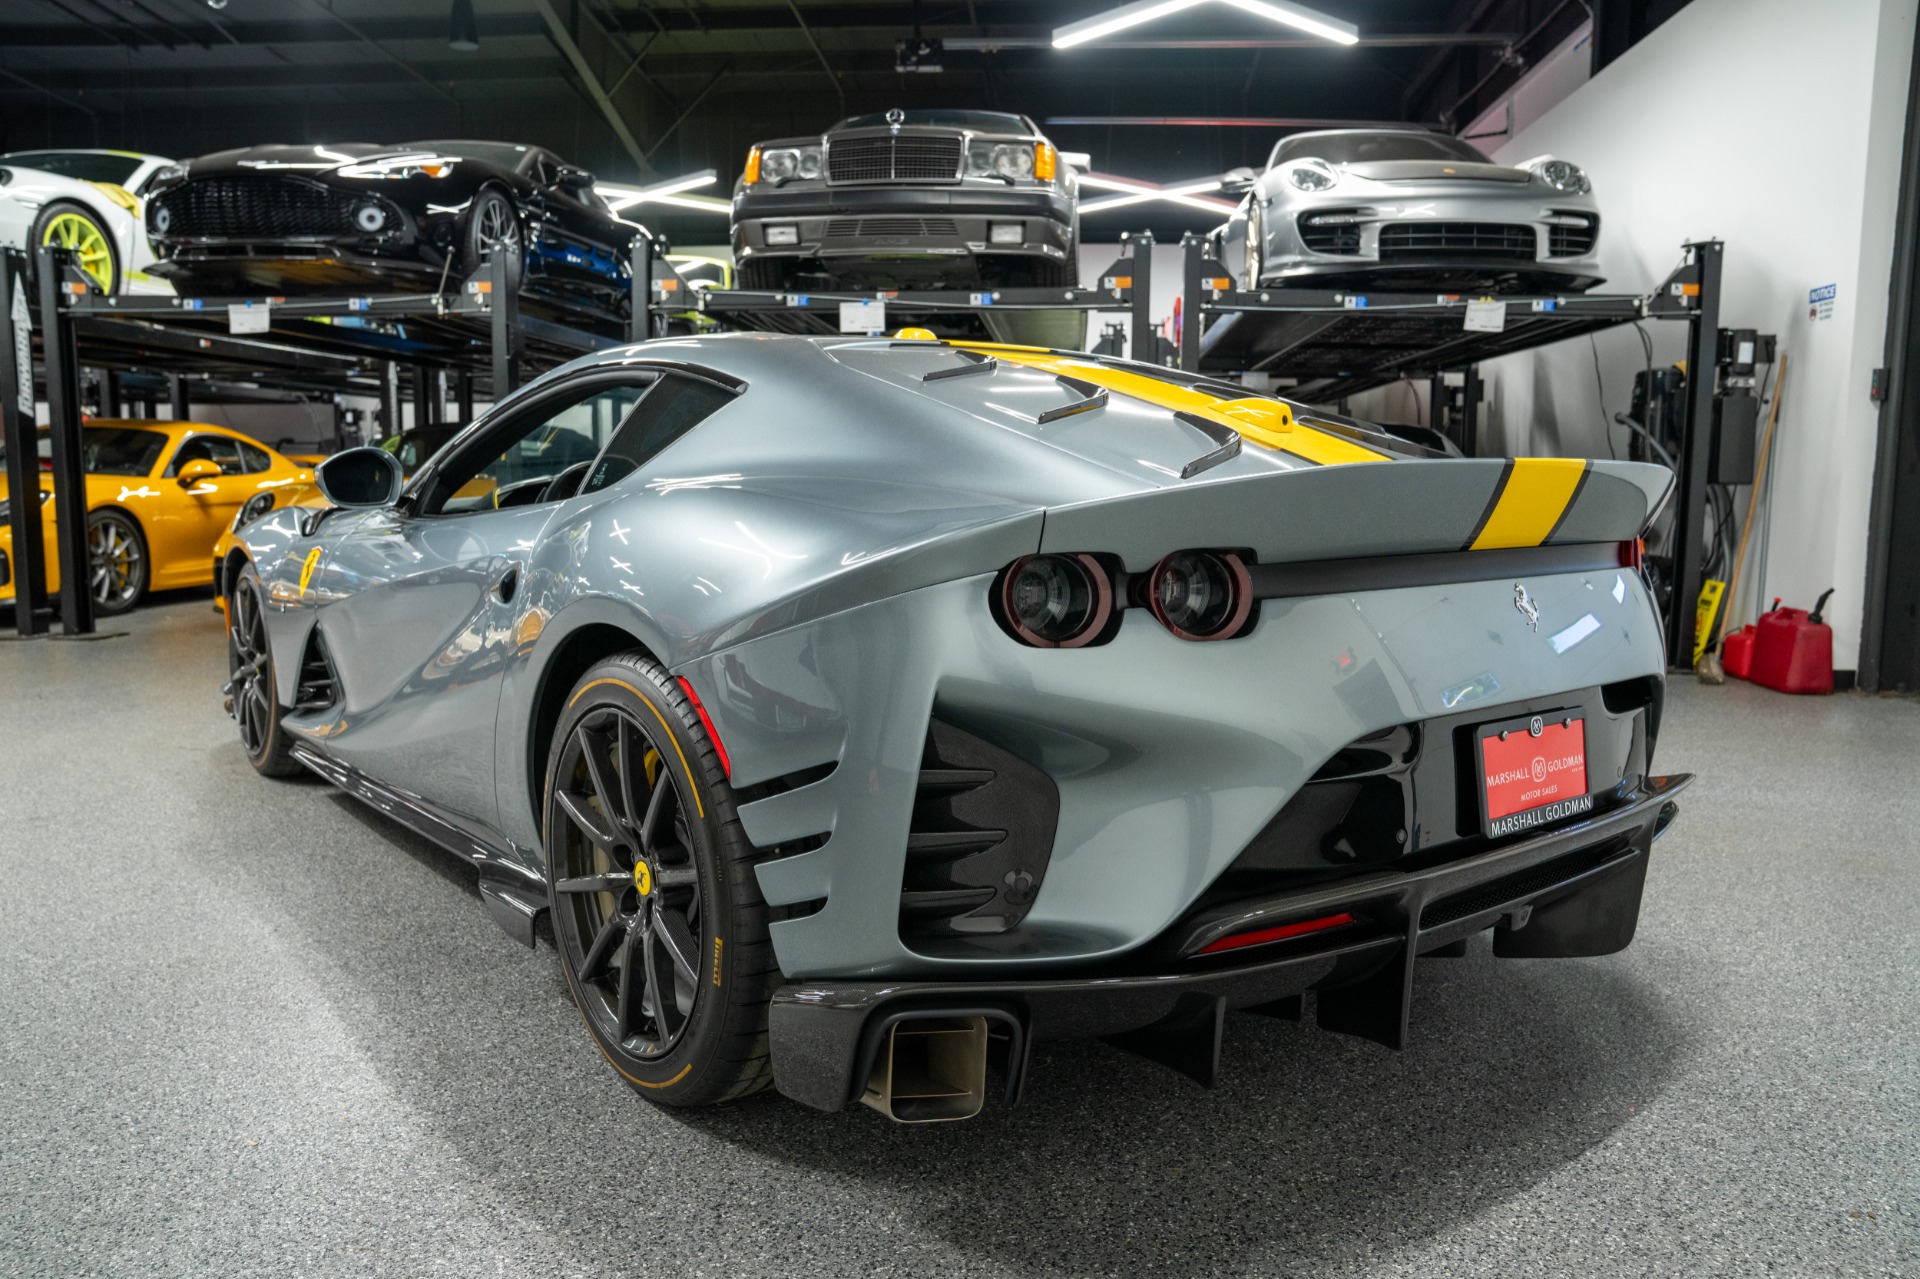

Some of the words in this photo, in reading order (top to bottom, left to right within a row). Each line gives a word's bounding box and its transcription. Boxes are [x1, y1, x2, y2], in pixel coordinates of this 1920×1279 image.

[1811, 286, 1834, 301] NOTICE
[1487, 768, 1529, 787] MARSHALL
[1547, 754, 1583, 772] GOLDMAN
[1520, 789, 1540, 801] MOTOR
[1541, 785, 1558, 795] SALES
[1491, 810, 1543, 837] MARSHALL
[1546, 796, 1591, 820] GOLDMAN
[712, 936, 724, 987] PIRELLI
